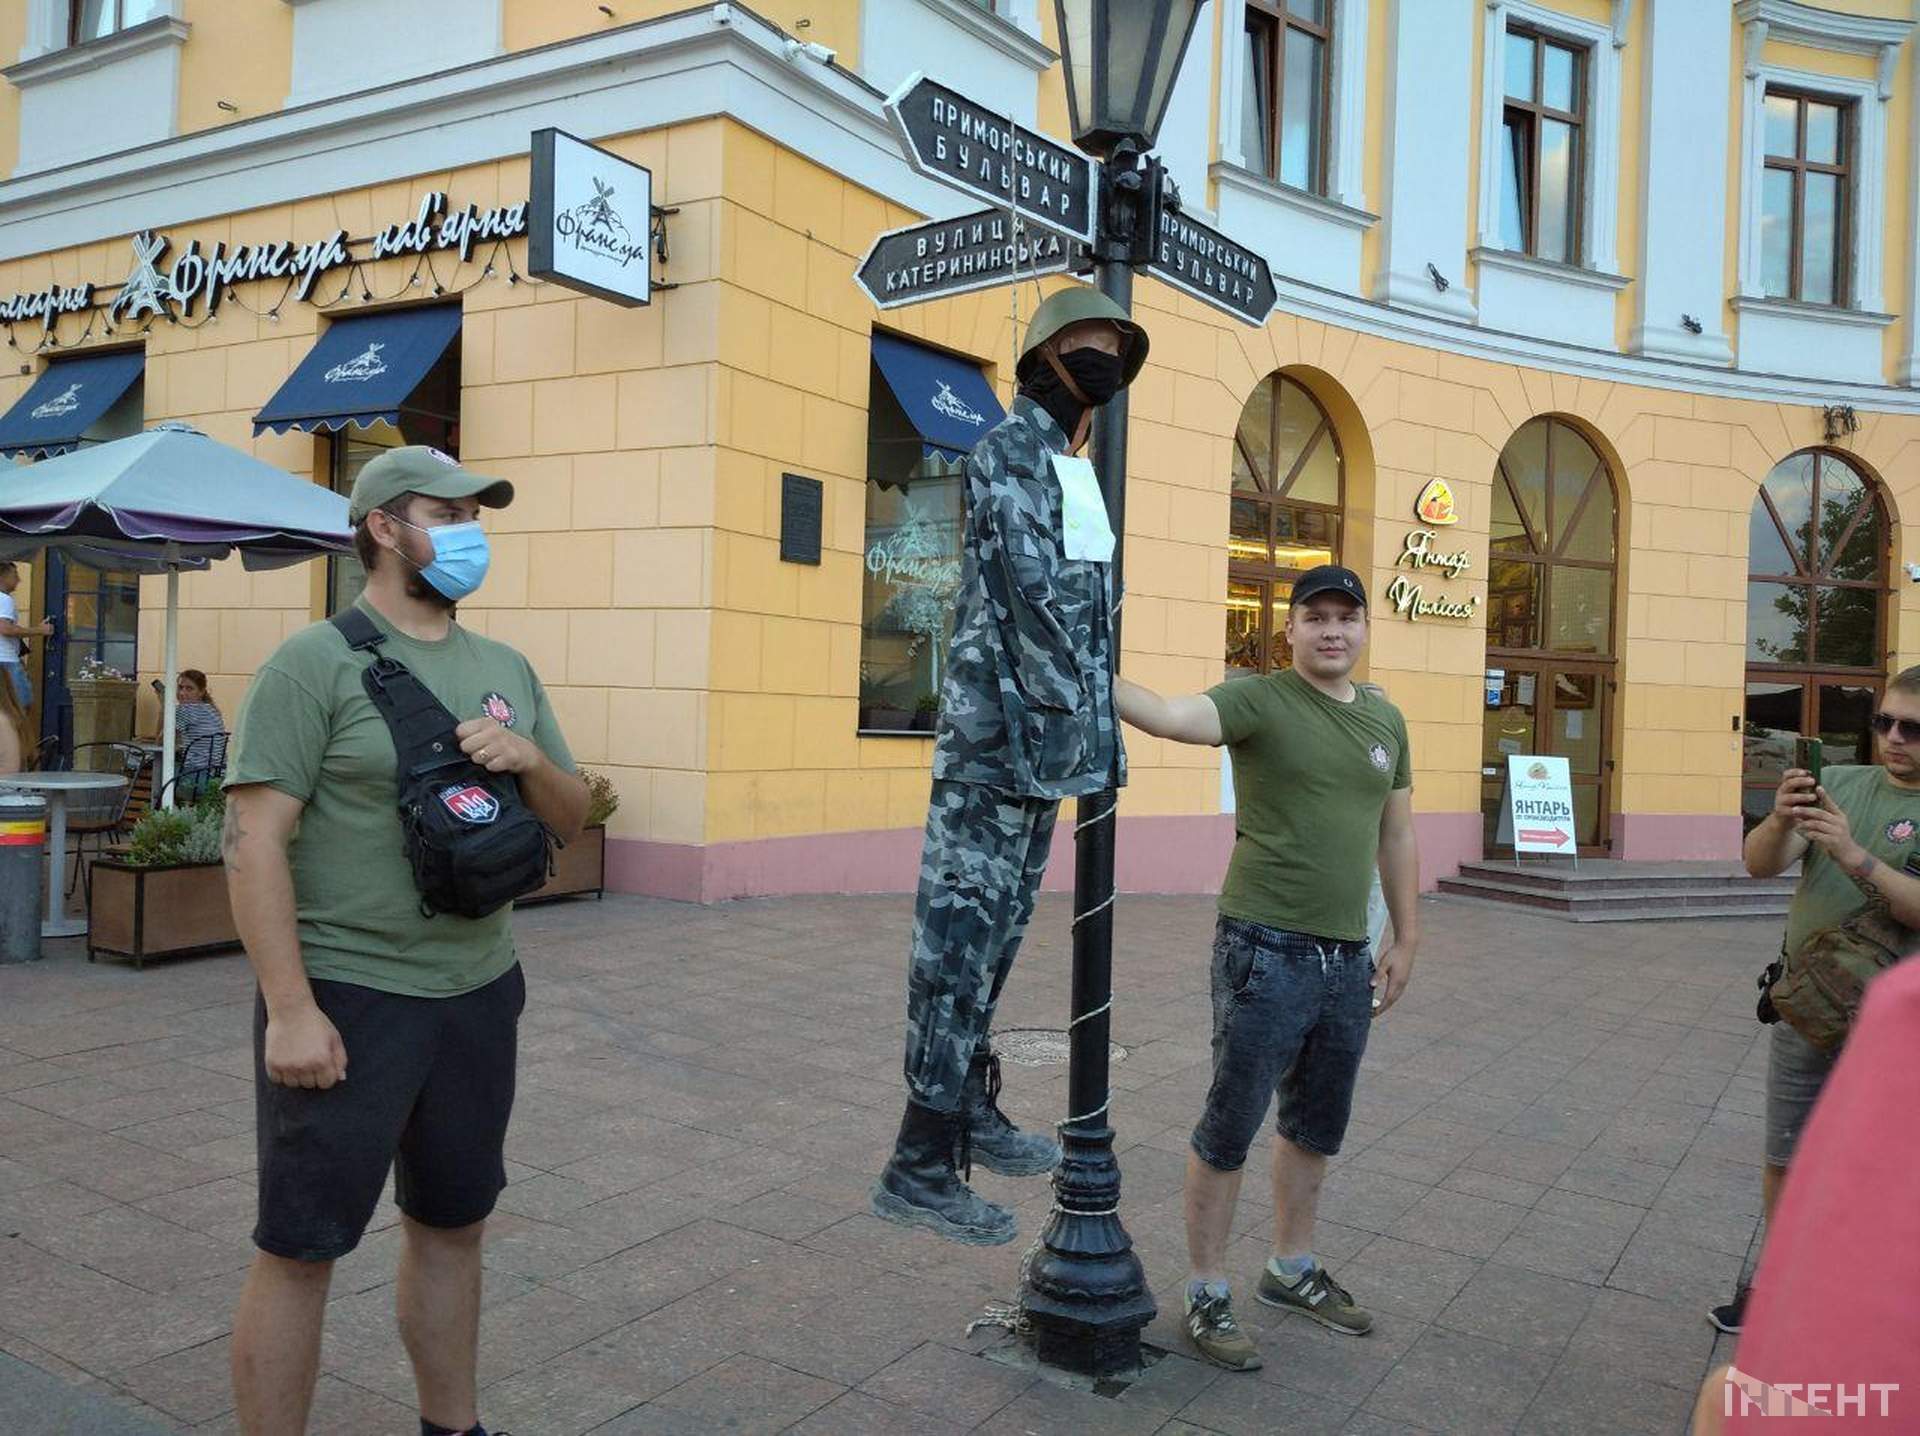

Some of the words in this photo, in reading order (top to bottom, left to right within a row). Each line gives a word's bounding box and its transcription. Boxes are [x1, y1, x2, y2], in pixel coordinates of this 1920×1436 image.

[933, 97, 1071, 184] ПРИМОРСЬКИЙ
[936, 135, 1070, 216] БУЛЬВАР
[886, 235, 1060, 291] КАТЕРИНИНСЬКА
[1161, 212, 1257, 282] ПРИМОРСЬКИЙ
[1161, 241, 1254, 304] БУЛЬВАР
[1399, 530, 1471, 579] Янтар
[1515, 800, 1570, 816] ЯНТАРЬ
